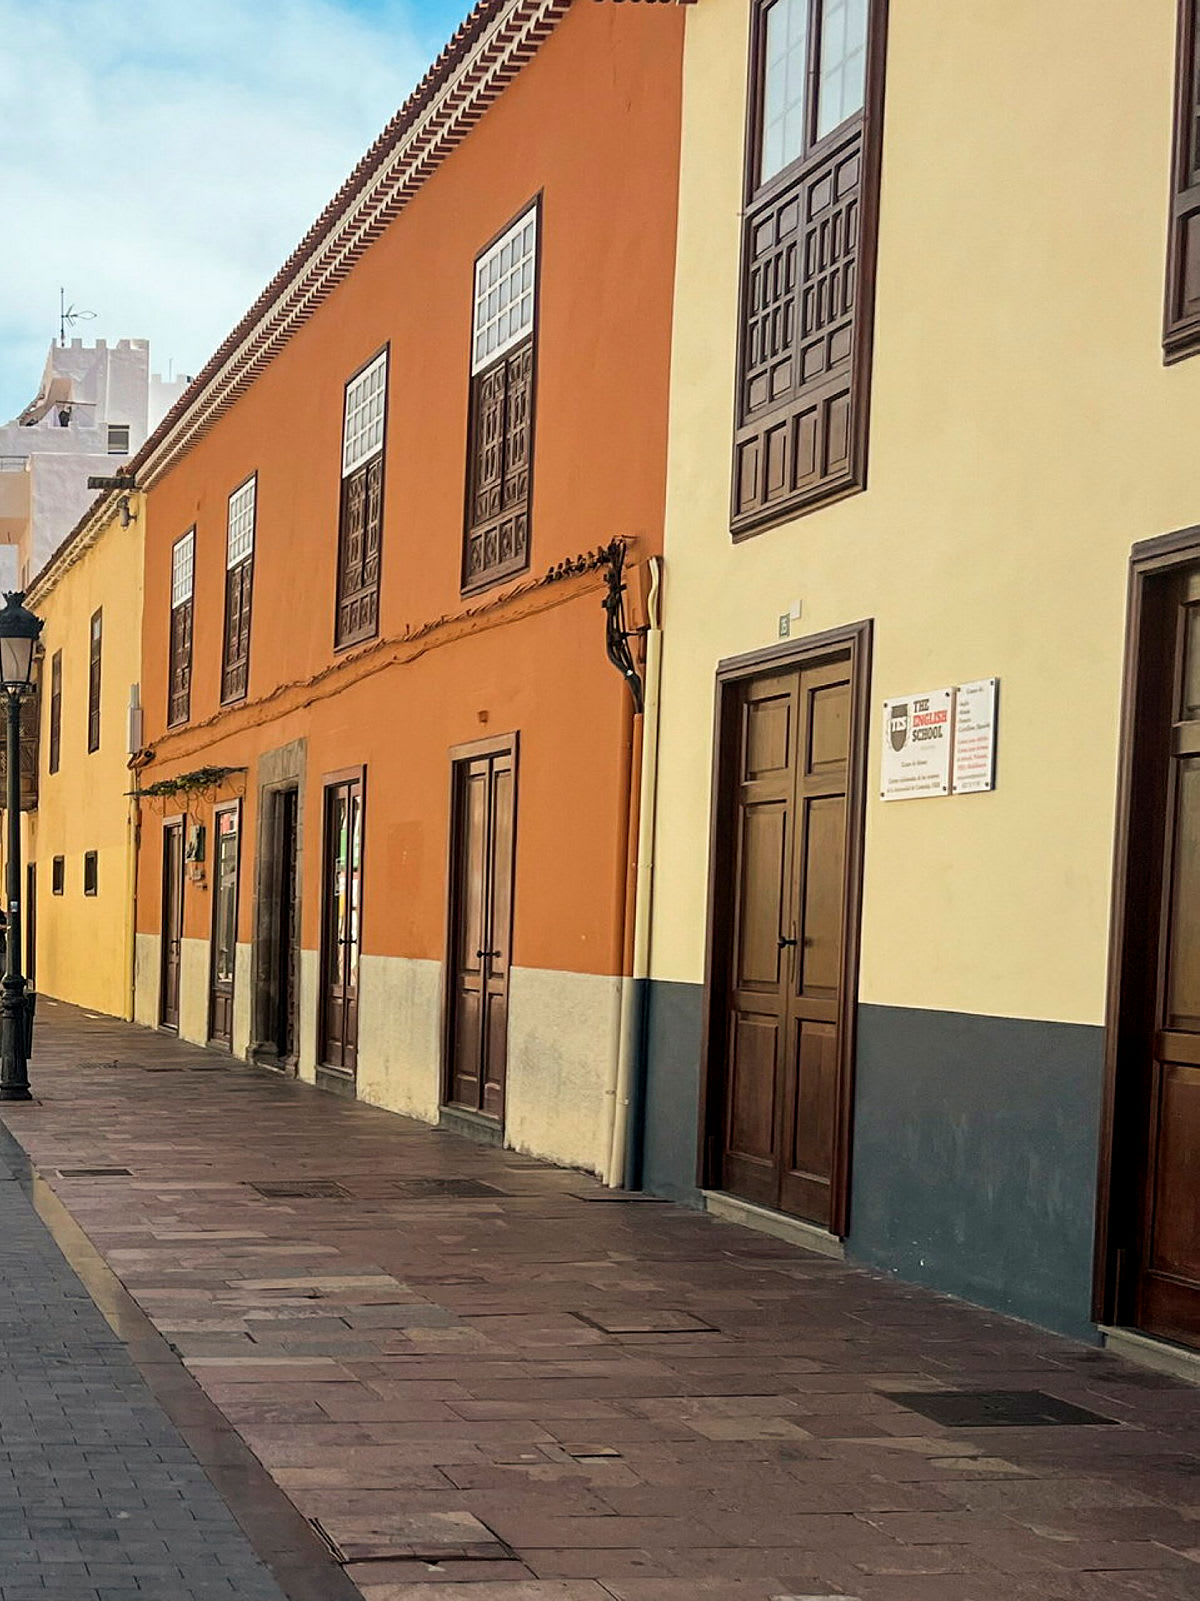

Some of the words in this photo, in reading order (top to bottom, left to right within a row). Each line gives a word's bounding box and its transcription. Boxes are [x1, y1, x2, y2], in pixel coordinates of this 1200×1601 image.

[913, 699, 929, 713] THE
[913, 710, 947, 728] ENGLISH
[912, 725, 942, 742] SCHOOL
